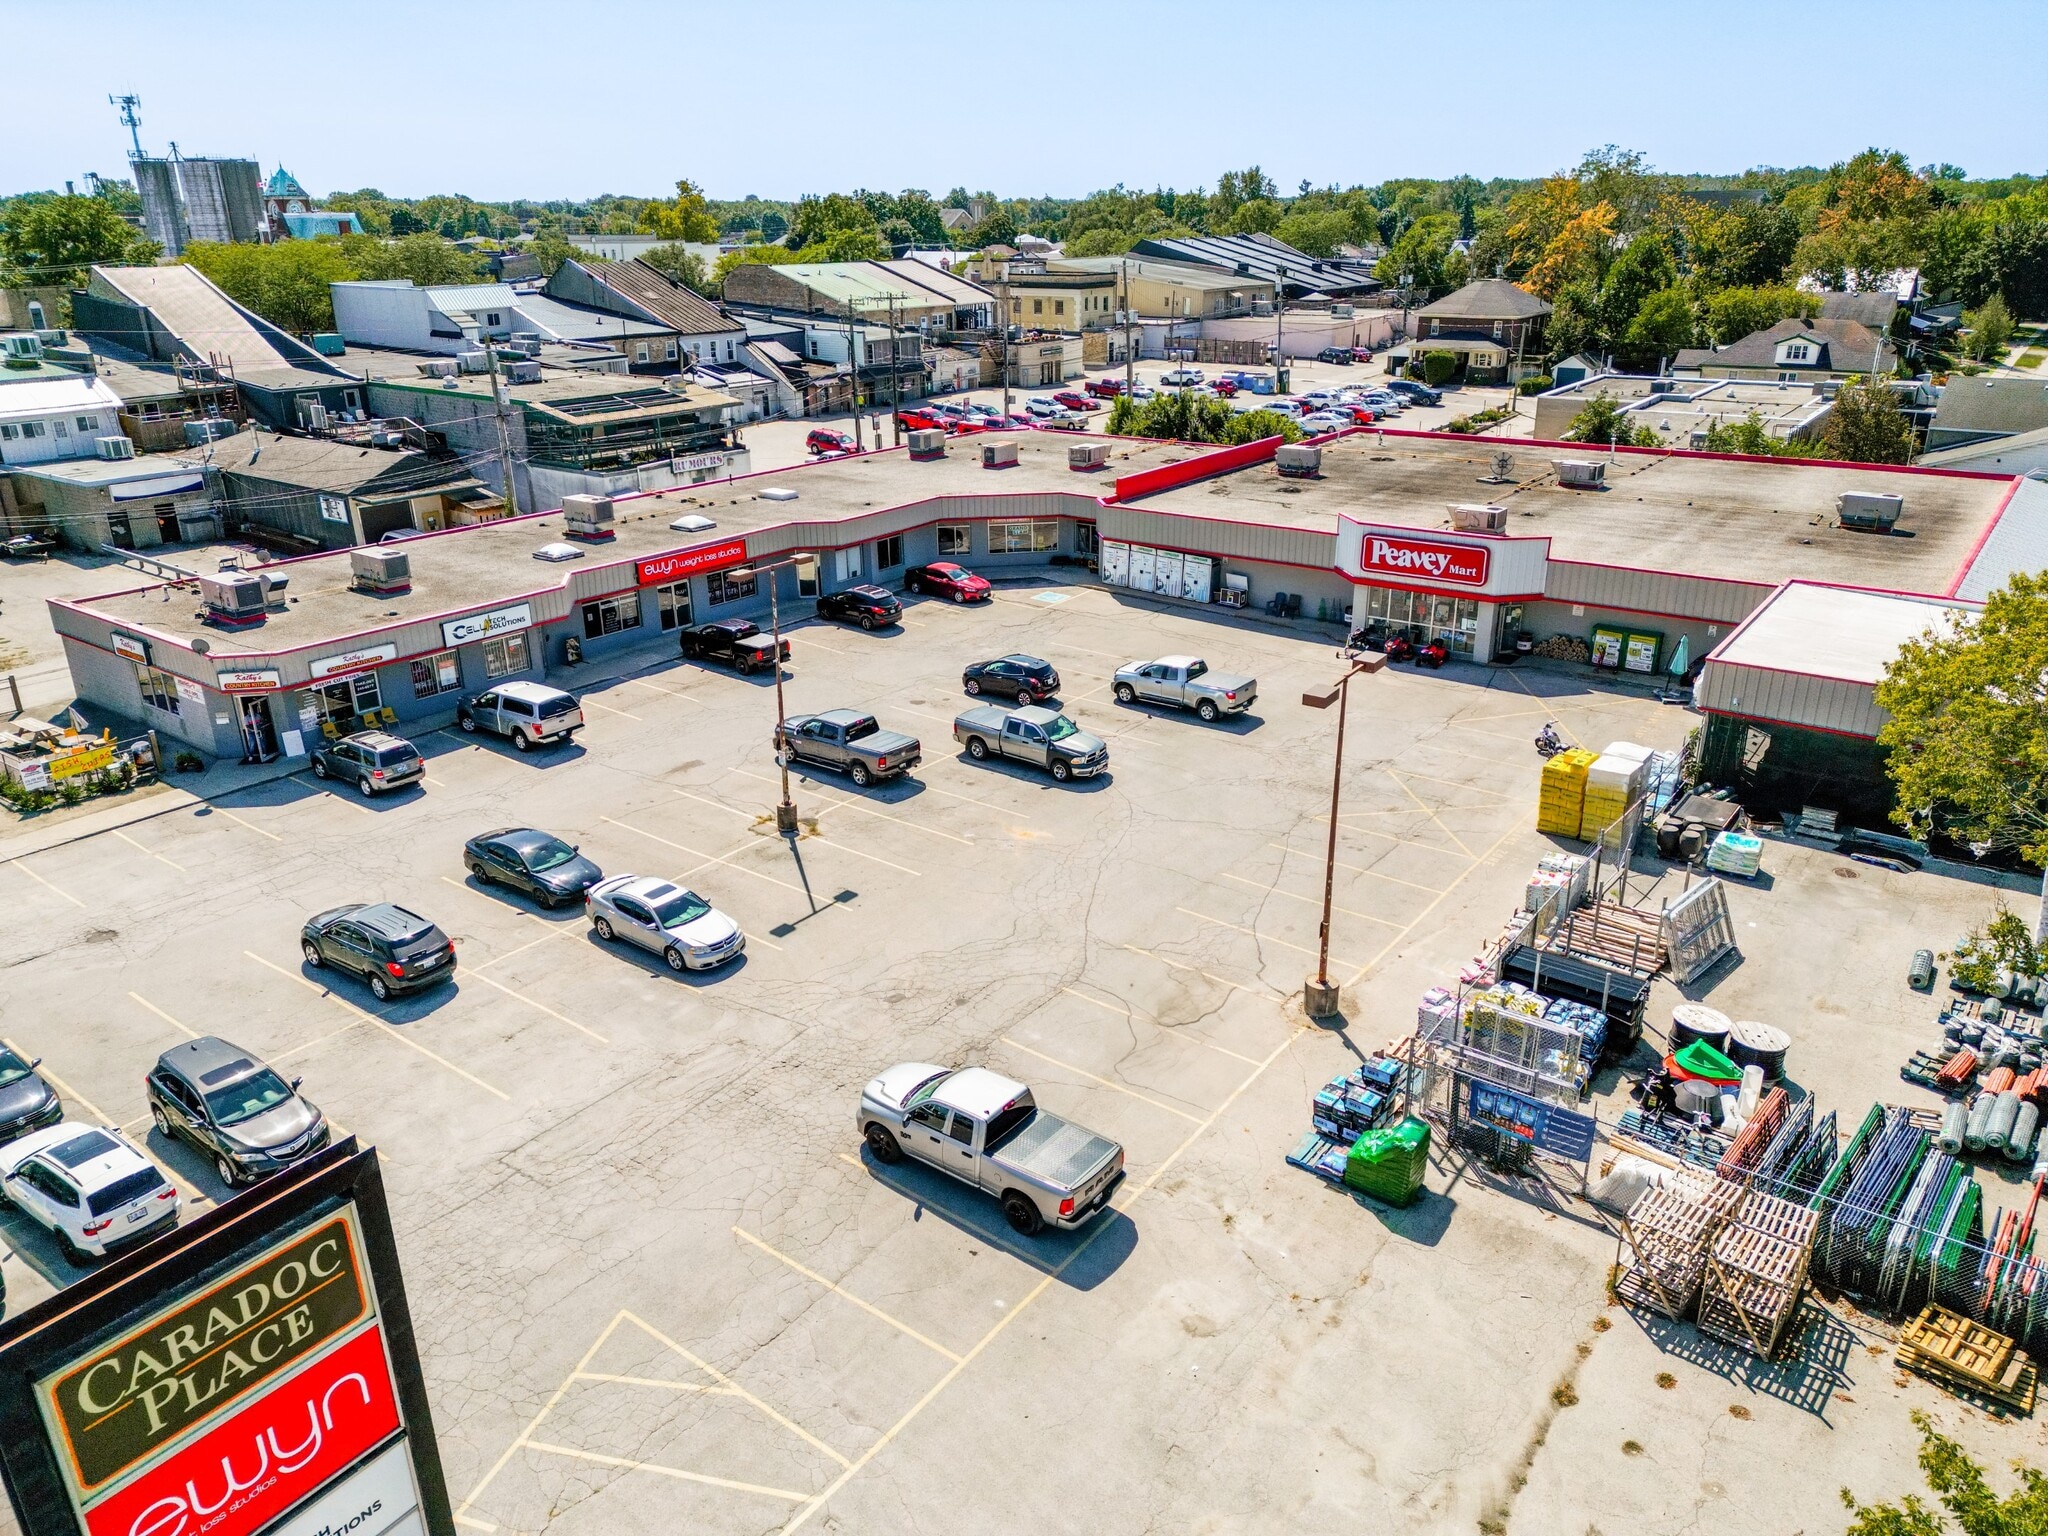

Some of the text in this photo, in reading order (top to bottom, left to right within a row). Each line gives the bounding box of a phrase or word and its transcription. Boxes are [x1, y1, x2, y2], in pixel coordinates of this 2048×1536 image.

[674, 456, 723, 471] RUMOURS
[644, 547, 741, 575] ewyn weight loss studios
[1370, 539, 1477, 576] Peavey Mart
[452, 616, 506, 639] CELL TECH
[490, 616, 526, 630] SOLUTIONS
[329, 656, 382, 672] COUNTRY KITCHEN
[342, 652, 365, 662] Kathy's
[235, 673, 262, 682] Kathy's
[53, 757, 79, 774] FISH
[81, 751, 110, 770] CHIPS
[1084, 1165, 1114, 1197] RAM
[78, 1239, 341, 1414] CARADOC
[136, 1304, 314, 1436] PLACE
[127, 1372, 371, 1536] ewyn
[200, 1475, 277, 1532] loss studios
[329, 1499, 383, 1536] TIONS
